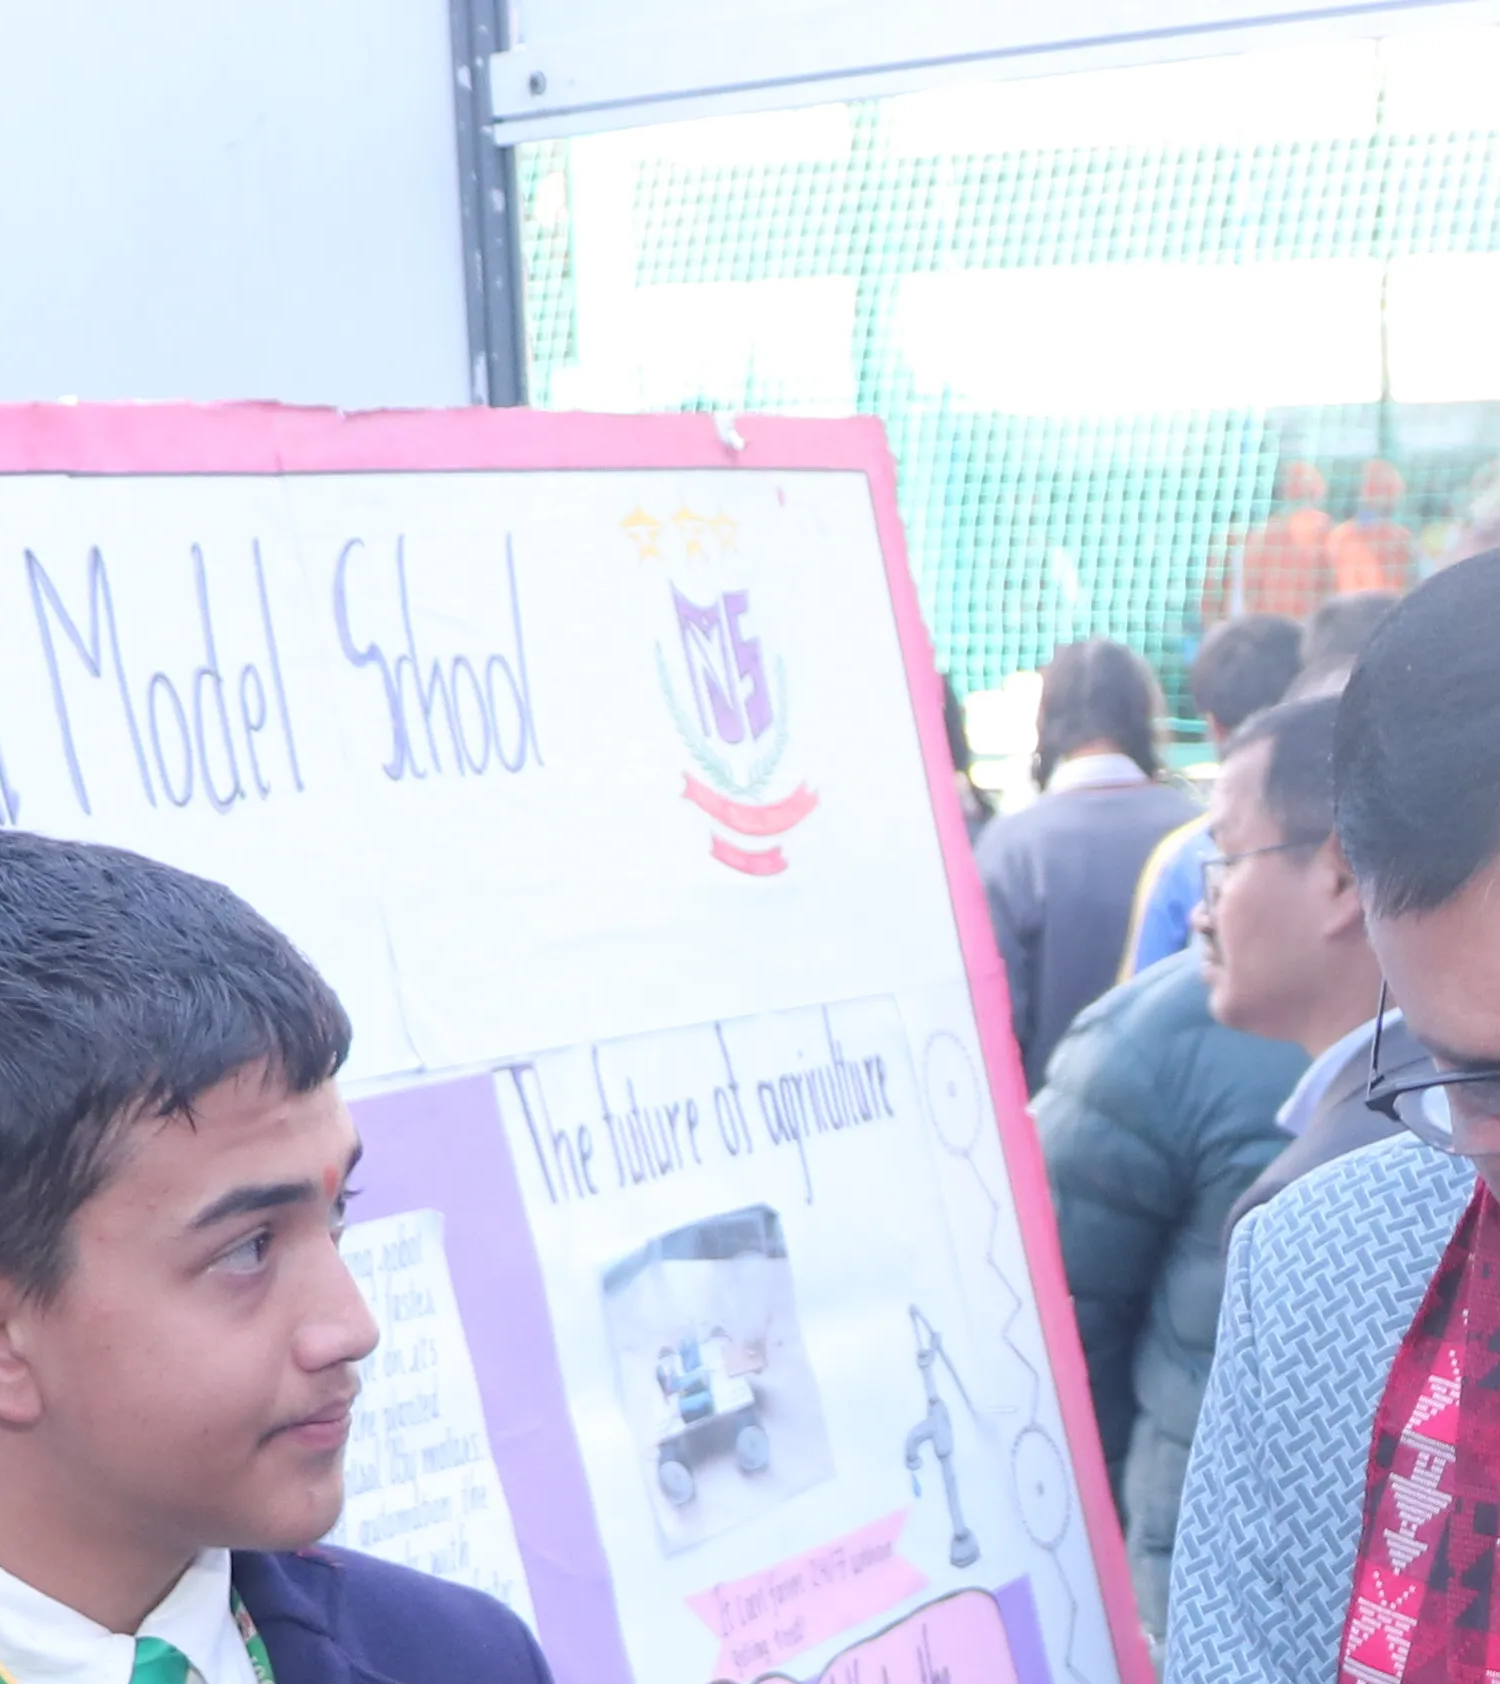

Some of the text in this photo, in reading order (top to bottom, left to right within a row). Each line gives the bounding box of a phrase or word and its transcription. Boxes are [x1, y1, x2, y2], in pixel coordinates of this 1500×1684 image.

[24, 536, 306, 816] Model
[333, 533, 544, 782] School
[492, 1060, 601, 1205] The
[591, 1042, 704, 1189] future
[712, 1020, 756, 1157] of
